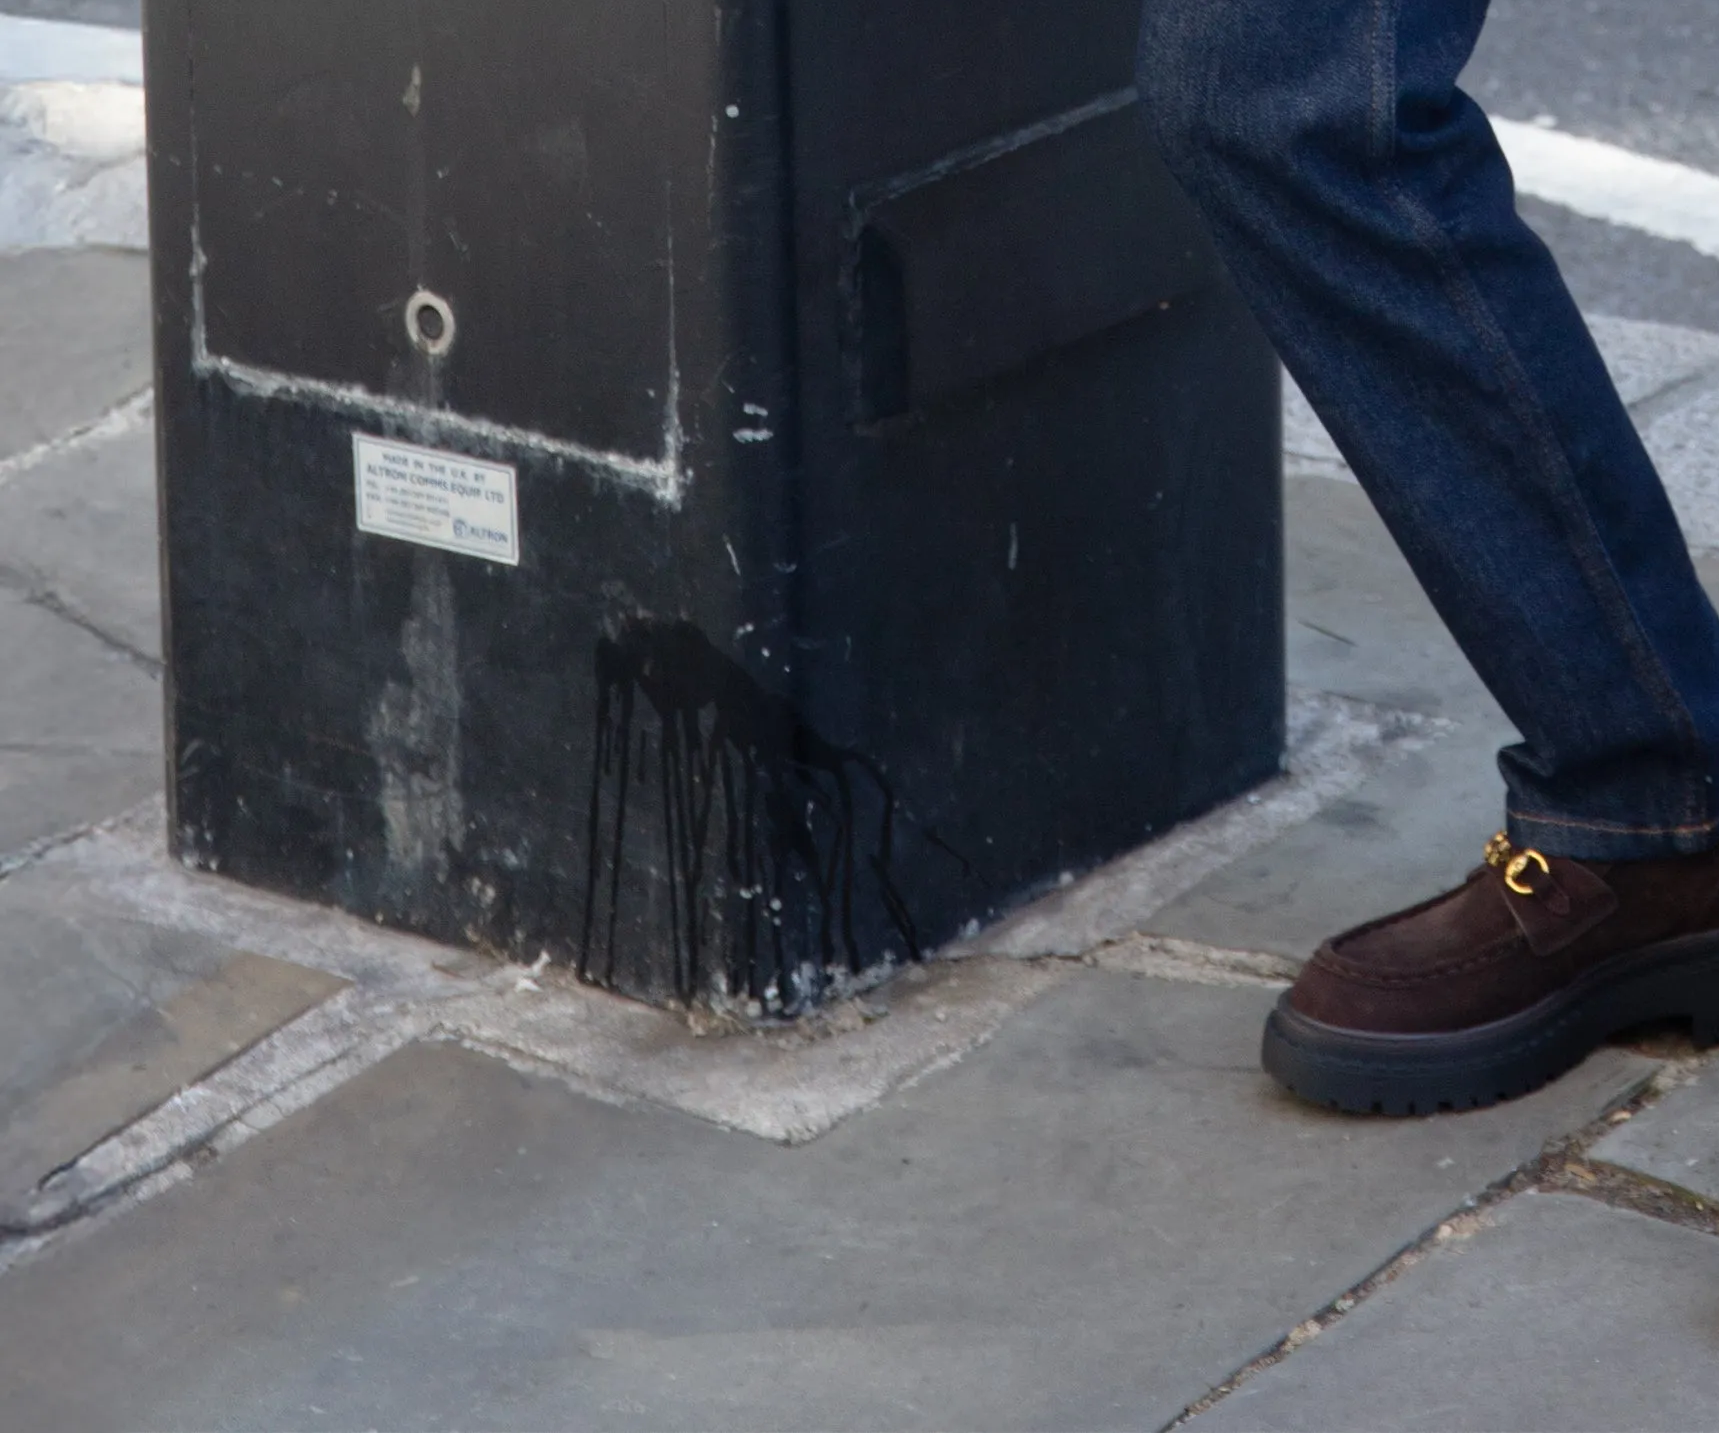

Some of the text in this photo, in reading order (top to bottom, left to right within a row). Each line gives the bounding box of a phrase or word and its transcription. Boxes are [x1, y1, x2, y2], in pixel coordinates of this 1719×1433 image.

[382, 453, 409, 466] MADE
[414, 459, 425, 470] IN
[429, 463, 447, 475] THE
[367, 464, 407, 481] ALTRON
[451, 486, 482, 499] EQUIP
[485, 491, 505, 505] LTD
[470, 527, 508, 543] ALTRON
